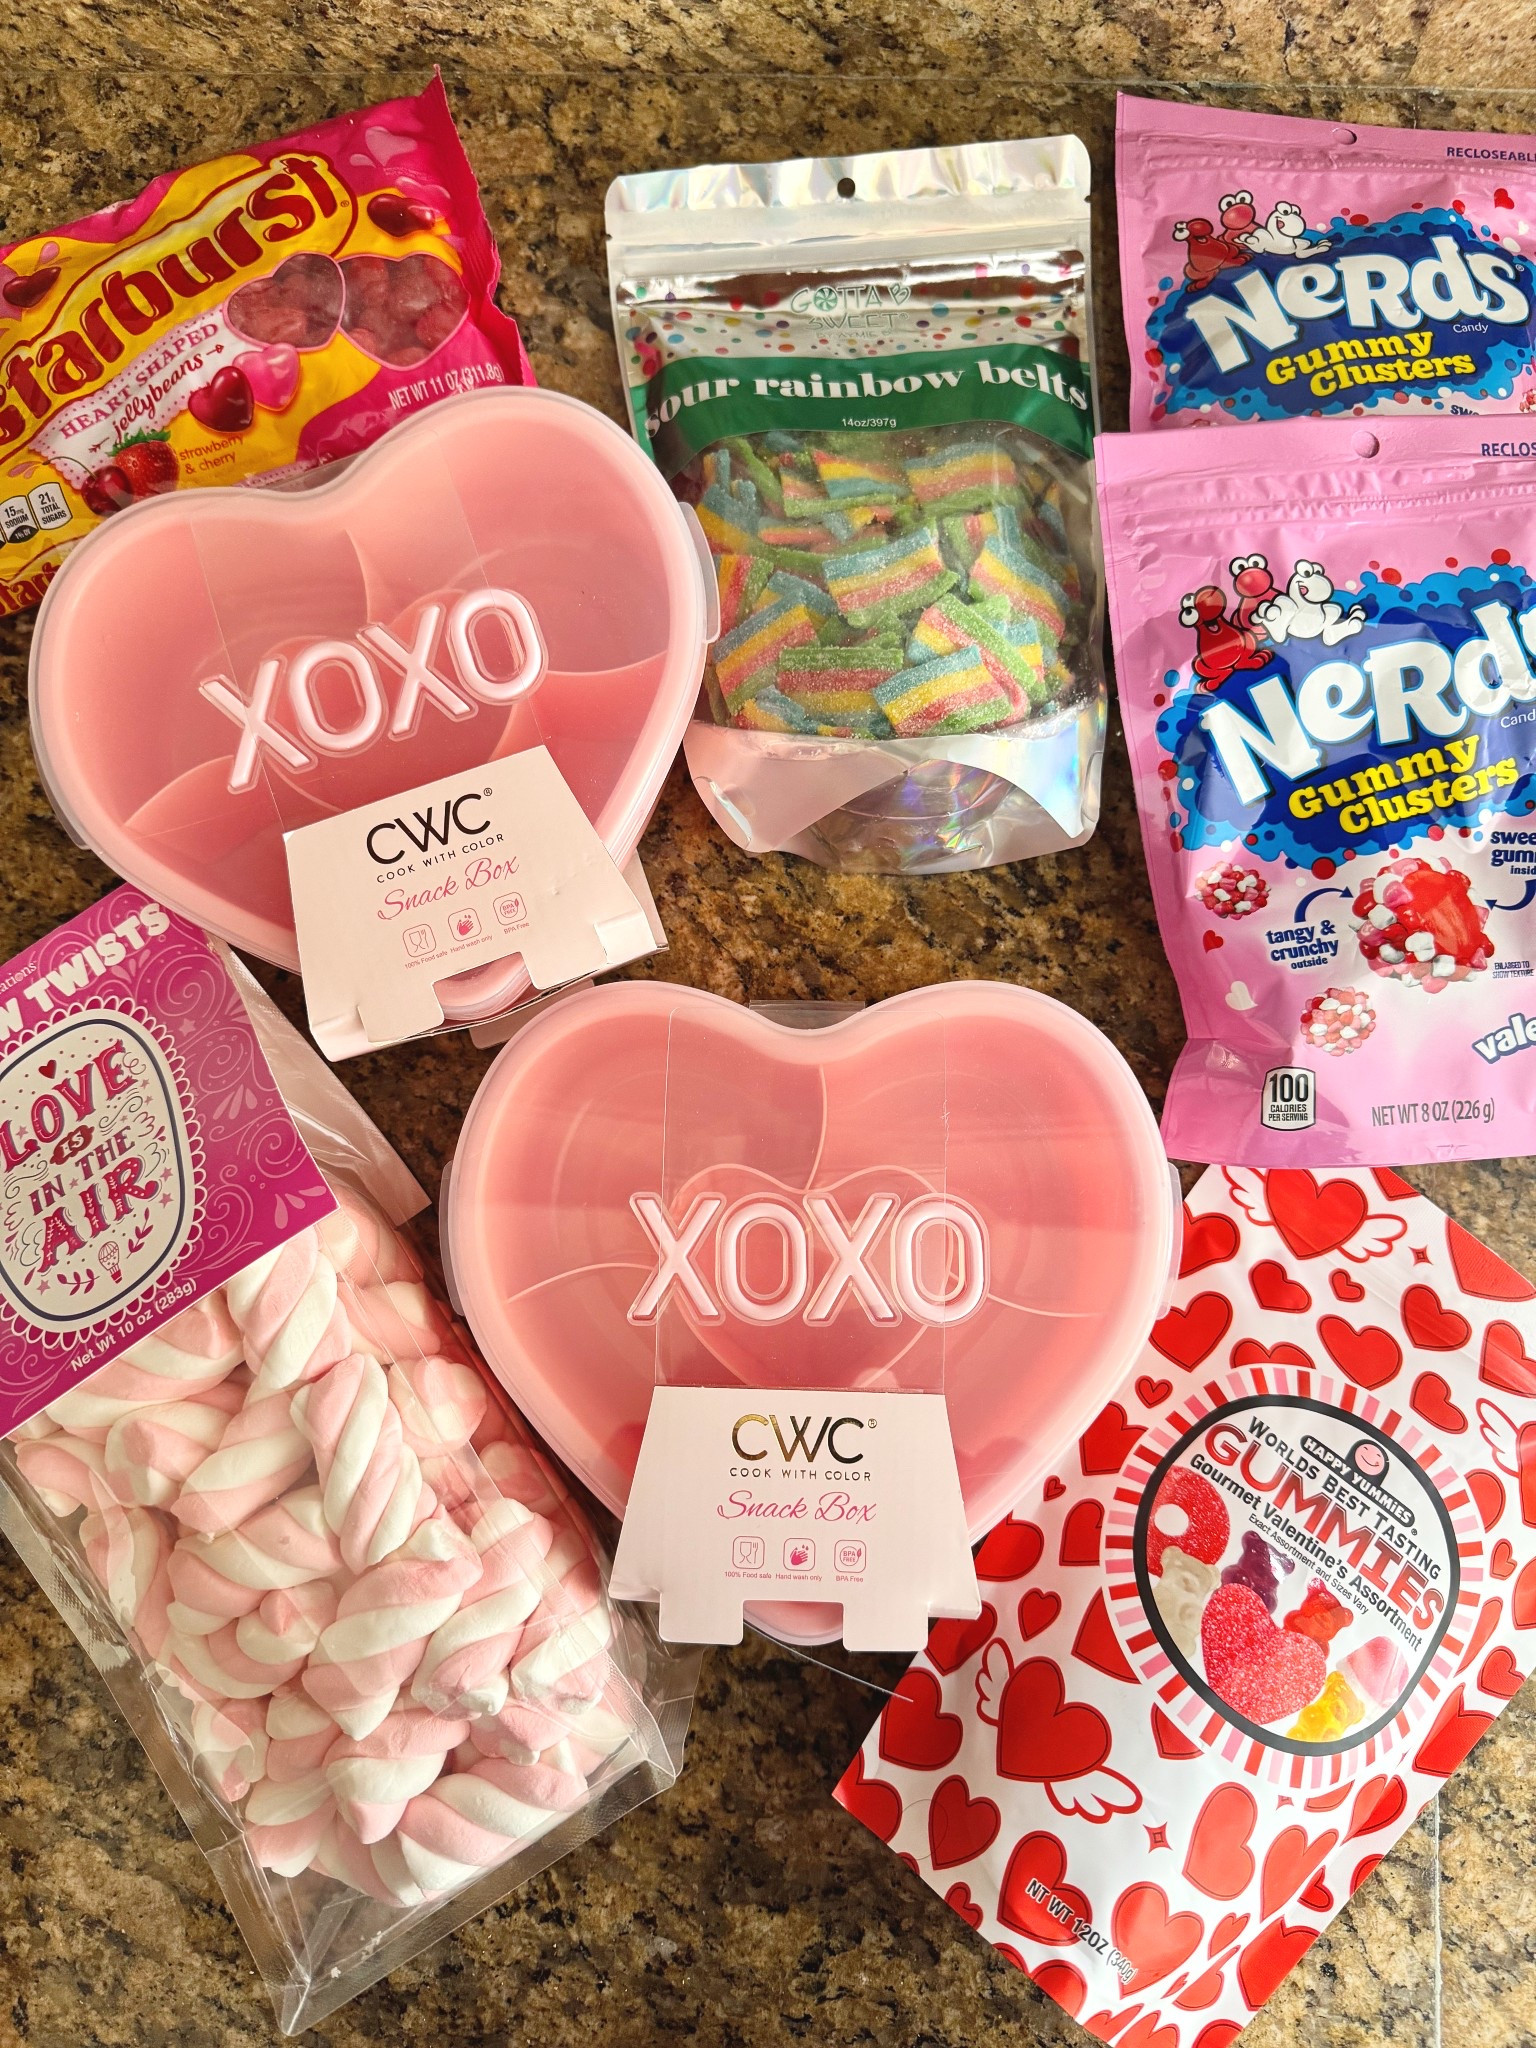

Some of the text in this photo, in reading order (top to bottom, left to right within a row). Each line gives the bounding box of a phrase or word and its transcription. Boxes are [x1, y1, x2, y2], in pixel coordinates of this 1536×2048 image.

[1447, 146, 1536, 162] RECLOSEABL
[1453, 321, 1489, 336] Candy
[1265, 331, 1434, 385] Gummy
[1309, 350, 1476, 397] Clusters
[60, 322, 220, 440] HEART SHAPED
[113, 353, 204, 444] jellybeans
[388, 386, 412, 411] NET
[410, 380, 430, 402] WT
[430, 375, 444, 396] 11
[444, 369, 464, 394] OZ
[644, 359, 1089, 438] sour rainbow belts
[841, 418, 897, 428] 14oz/397g
[179, 435, 244, 461] strawberry
[185, 452, 237, 475] & cherry
[5, 513, 30, 529] SODIUM
[40, 504, 60, 515] TOTAL
[42, 510, 67, 525] SUGARS
[198, 587, 549, 795] XOXO
[1288, 734, 1480, 819] Gummy
[1339, 756, 1519, 835] Clusters
[366, 793, 491, 865] CWC
[376, 833, 504, 884] COOK WITH COLOR
[1491, 849, 1536, 867] gum
[377, 856, 520, 921] Snack Box
[450, 934, 493, 954] Hand wash only
[503, 921, 530, 935] BPA Free
[1266, 919, 1336, 945] tangy &
[23, 902, 171, 1013] TWISTS
[404, 950, 448, 970] 100% Food safe
[1270, 938, 1339, 962] crunchy
[1290, 956, 1328, 970] outside
[1492, 970, 1510, 979] SHOW
[0, 1039, 138, 1173] LOVE
[1268, 1073, 1309, 1102] 100
[1268, 1113, 1309, 1121] PER SERVING
[1270, 1104, 1307, 1112] CALORIES
[1371, 1105, 1395, 1127] NET
[1397, 1103, 1419, 1124] WT
[1421, 1103, 1430, 1122] 8
[1432, 1101, 1450, 1121] OZ
[1451, 1100, 1480, 1123] (226
[29, 1126, 136, 1216] IN THE
[37, 1156, 160, 1274] AIR
[626, 1191, 990, 1328] XOXO
[70, 1278, 197, 1372] Net Wt 10 oz (283g)
[731, 1413, 865, 1465] CWC
[1304, 1438, 1352, 1477] HAPPY
[729, 1467, 872, 1482] COOK WITH COLOR
[717, 1490, 877, 1525] Snack Box
[1247, 1415, 1442, 1580] WORLDS BEST TASTING
[1204, 1422, 1445, 1631] GUMMIES
[1190, 1453, 1423, 1651] Gourmet Valentine's Assortment
[1248, 1513, 1369, 1616] Exact Assortment and Sizes Vary
[742, 1571, 758, 1579] Food
[809, 1574, 823, 1582] only
[1027, 1879, 1138, 1985] NT WT 12OZ (340g)
